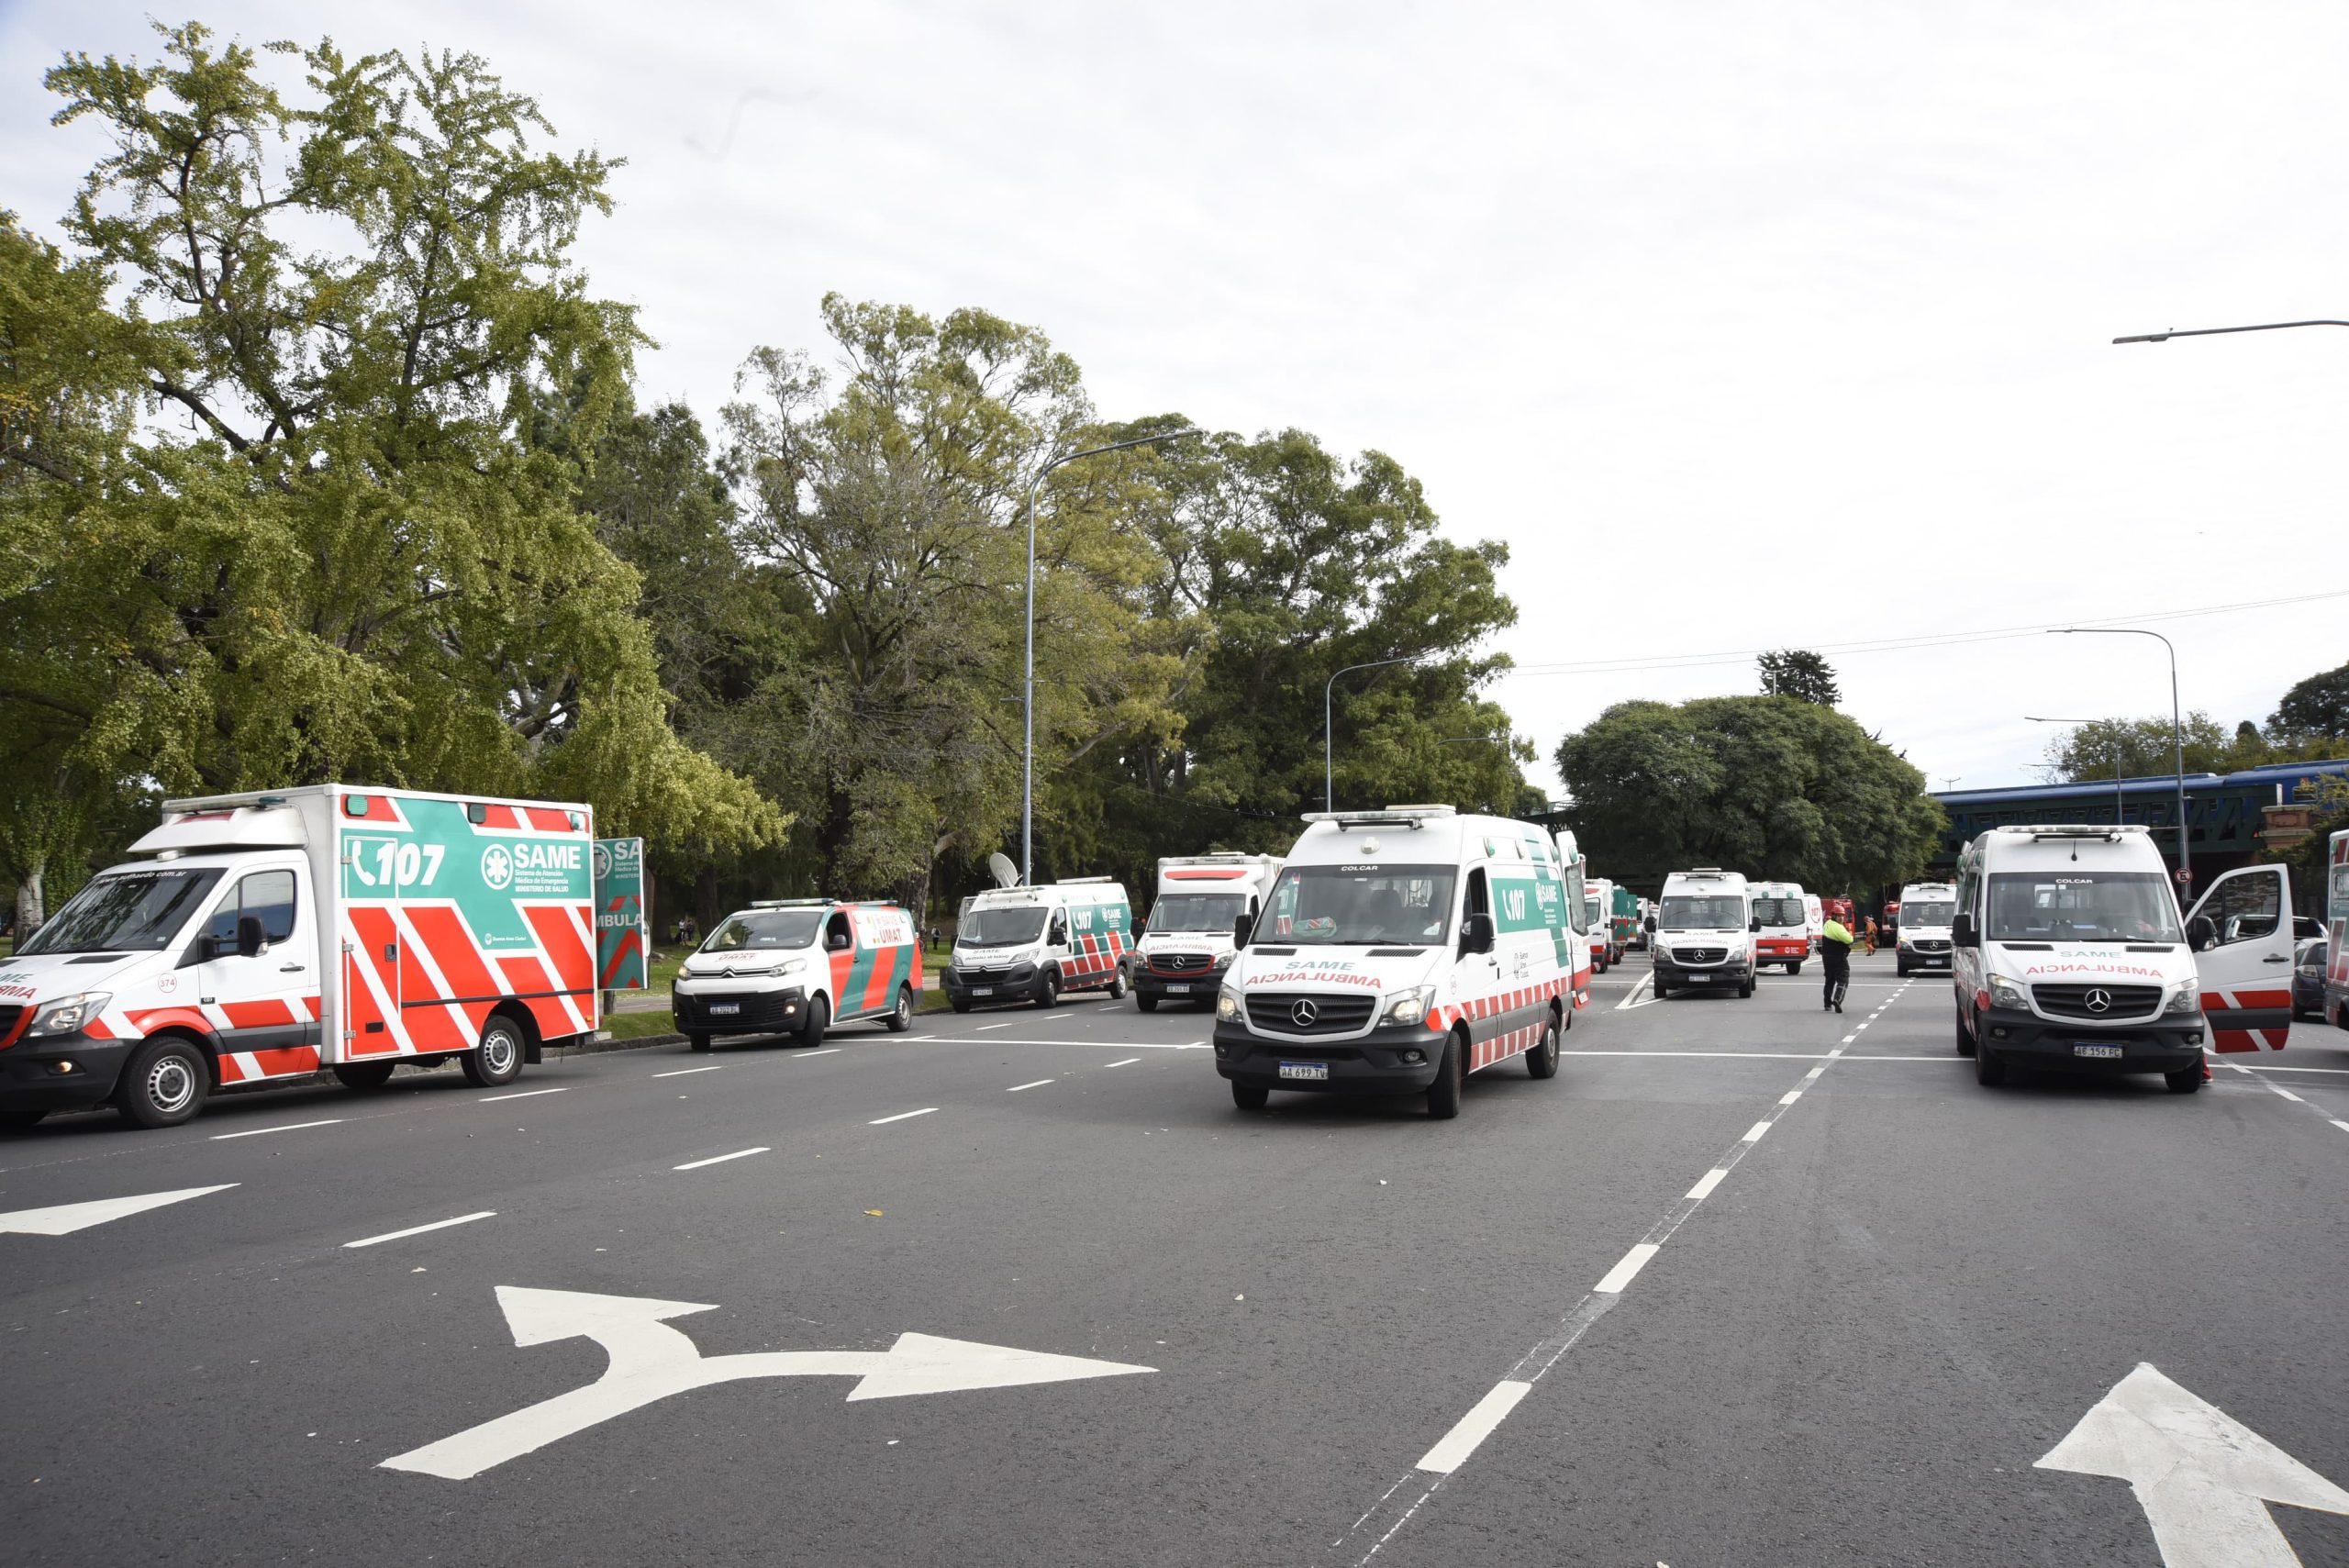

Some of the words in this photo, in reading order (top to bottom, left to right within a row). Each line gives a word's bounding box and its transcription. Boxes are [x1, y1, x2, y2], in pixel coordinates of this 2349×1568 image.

[514, 843, 581, 870] SAME
[614, 841, 640, 861] SA
[376, 842, 445, 885] 107
[1542, 884, 1558, 903] SAME
[1508, 888, 1525, 920] 107
[596, 913, 642, 927] MBULA
[1078, 911, 1092, 929] 107
[1108, 908, 1122, 918] SAME
[880, 928, 902, 943] UMAT
[2061, 951, 2122, 959] SAME
[1285, 962, 1355, 971] SAME
[0, 973, 34, 984] ME
[160, 978, 176, 988] 374
